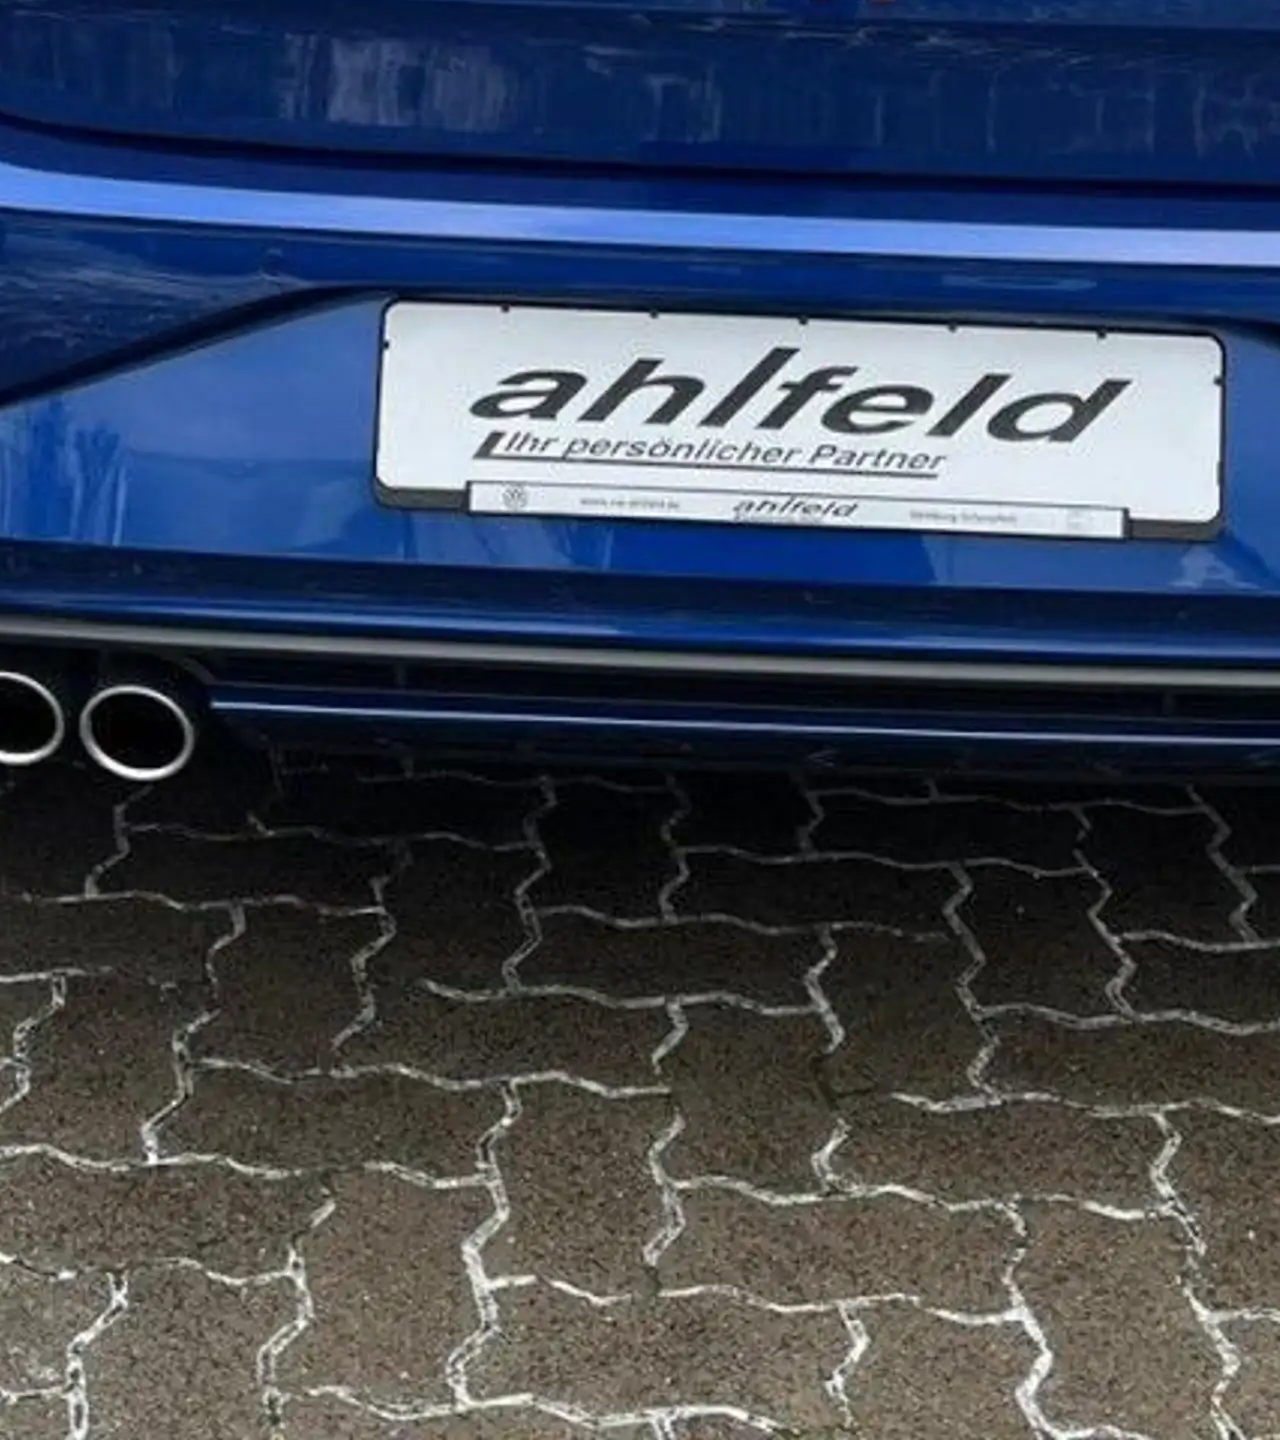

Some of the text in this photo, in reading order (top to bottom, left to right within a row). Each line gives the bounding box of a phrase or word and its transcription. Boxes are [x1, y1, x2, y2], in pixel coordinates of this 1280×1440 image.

[469, 346, 1133, 443] ahlfeld
[504, 430, 948, 471] Ihr persönlicher Partner
[732, 495, 859, 517] ahlfeld
